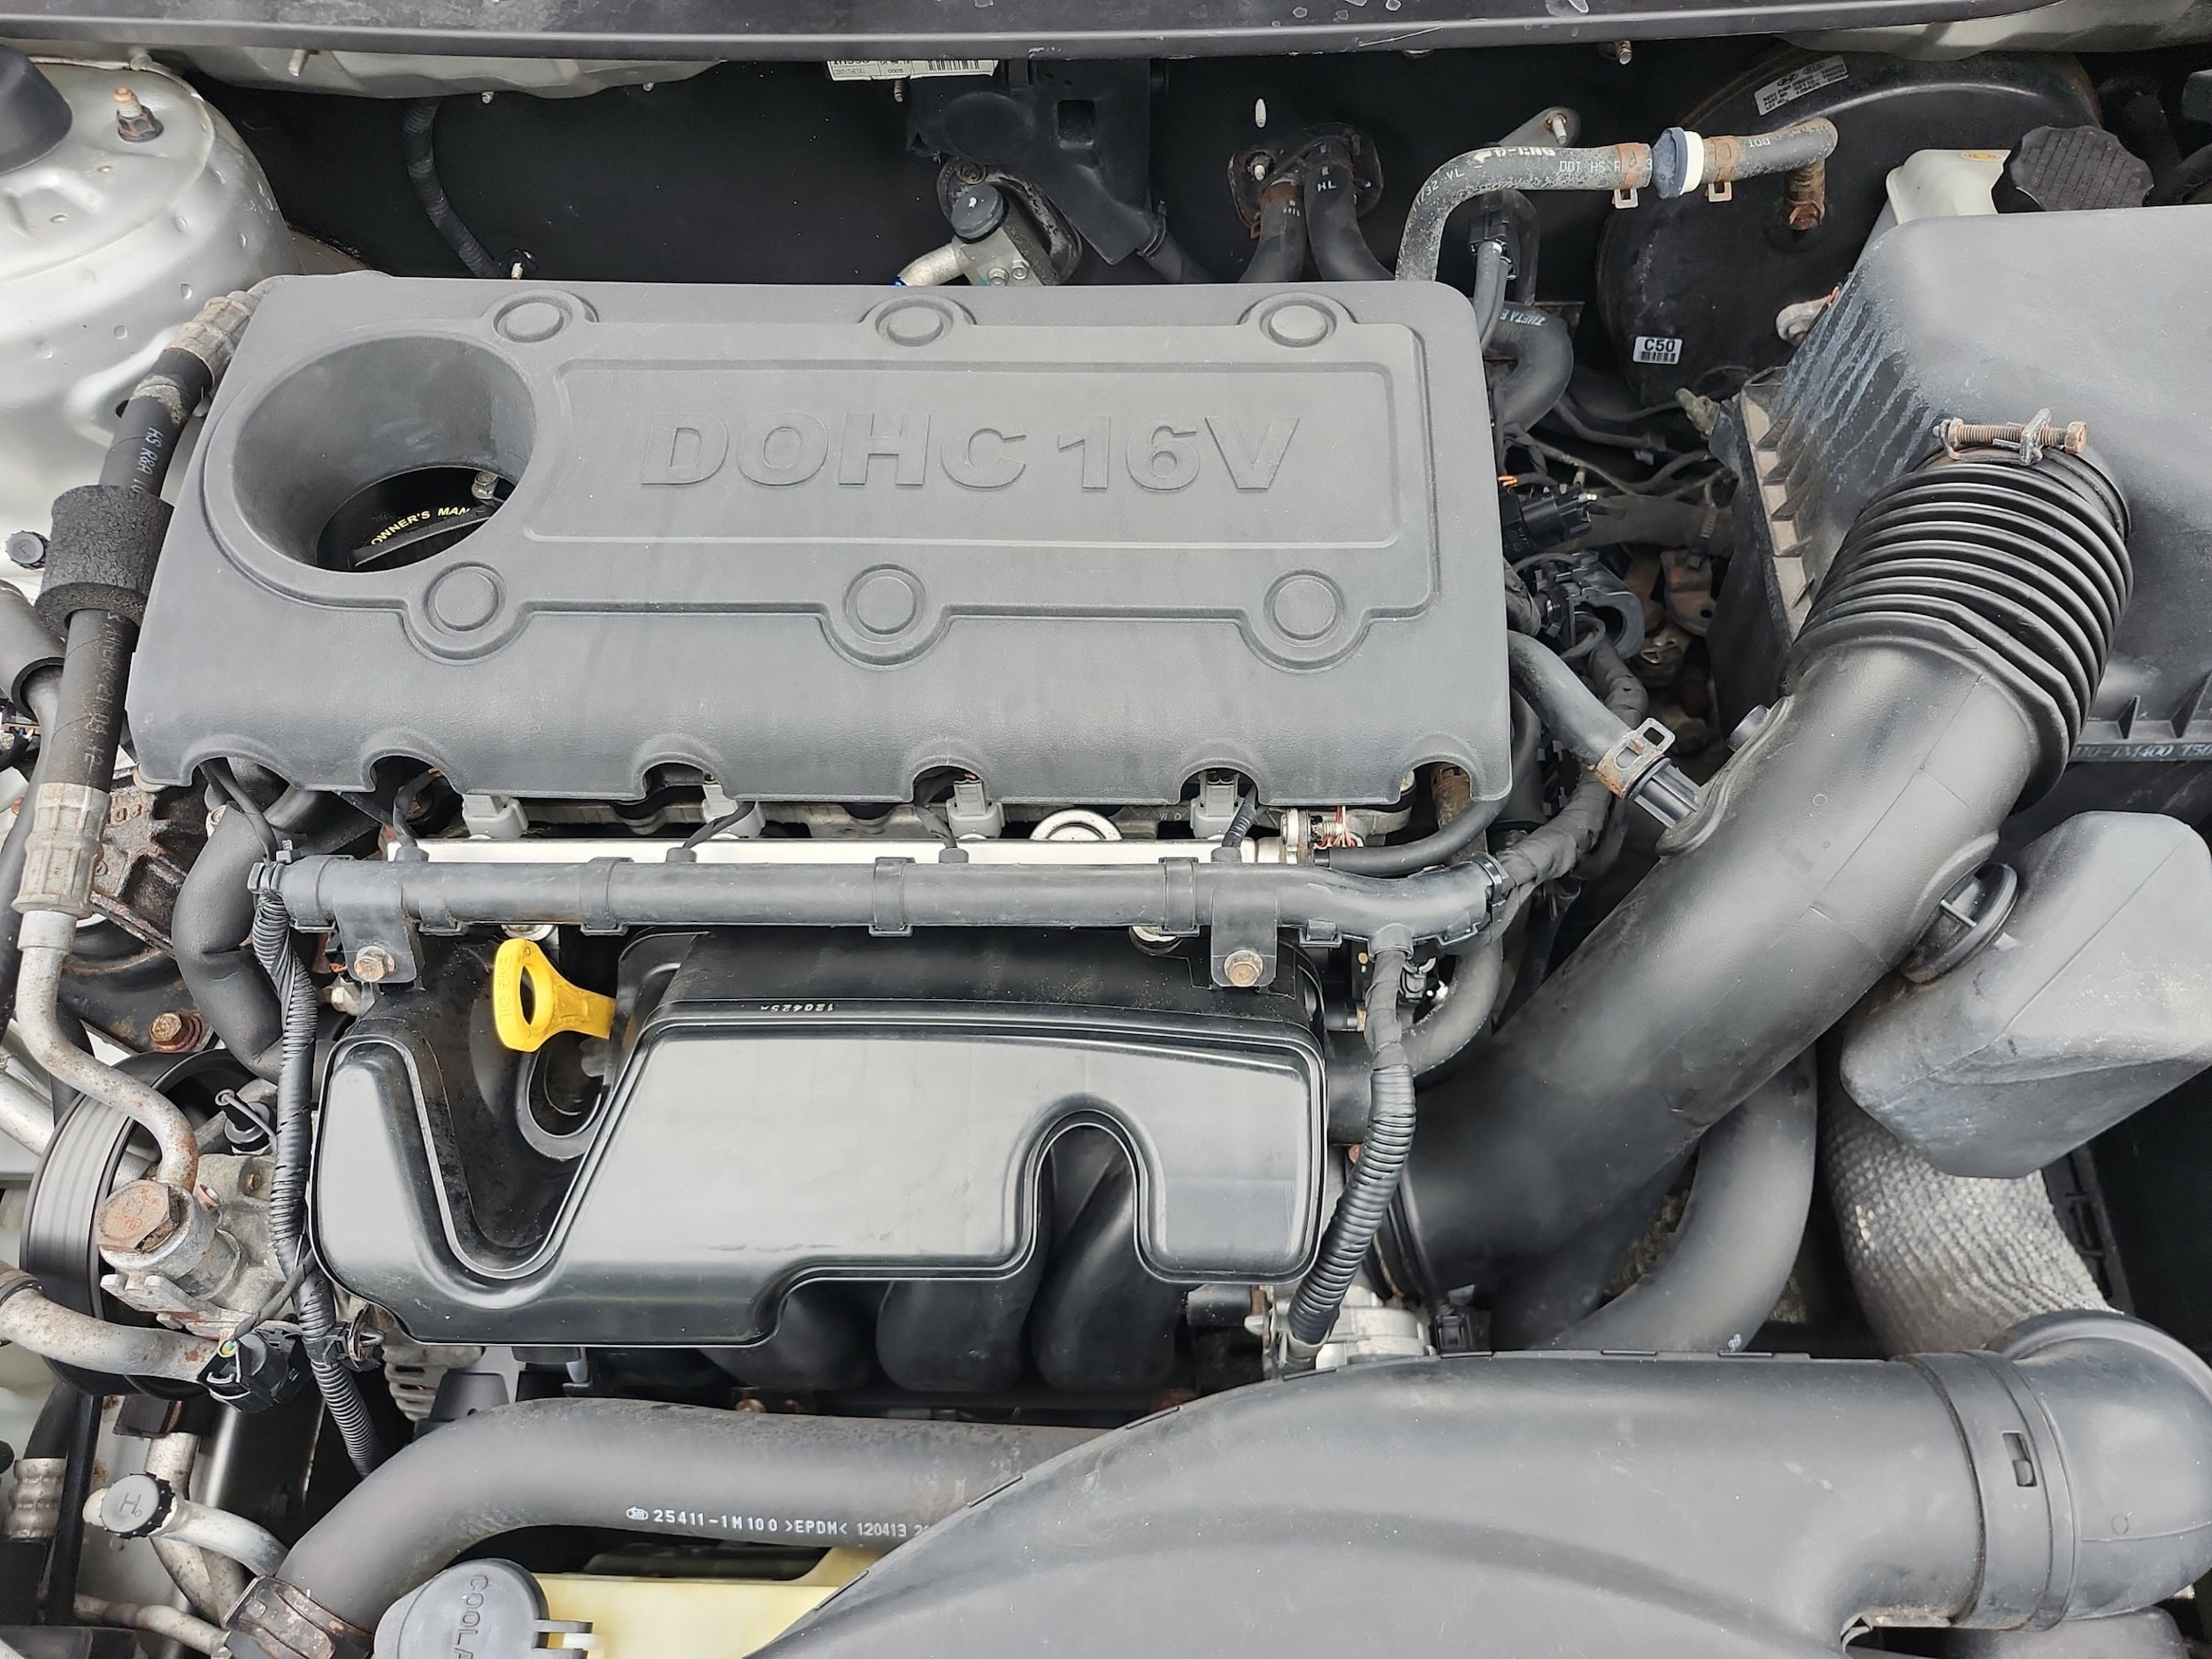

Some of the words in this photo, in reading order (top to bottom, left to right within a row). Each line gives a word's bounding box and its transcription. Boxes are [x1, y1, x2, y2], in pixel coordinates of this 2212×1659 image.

[1643, 338, 1676, 353] C50
[640, 411, 1027, 489] DOHC
[1057, 414, 1301, 492] 16V
[371, 511, 431, 546] OWNER'S
[856, 1522, 908, 1538] 120413
